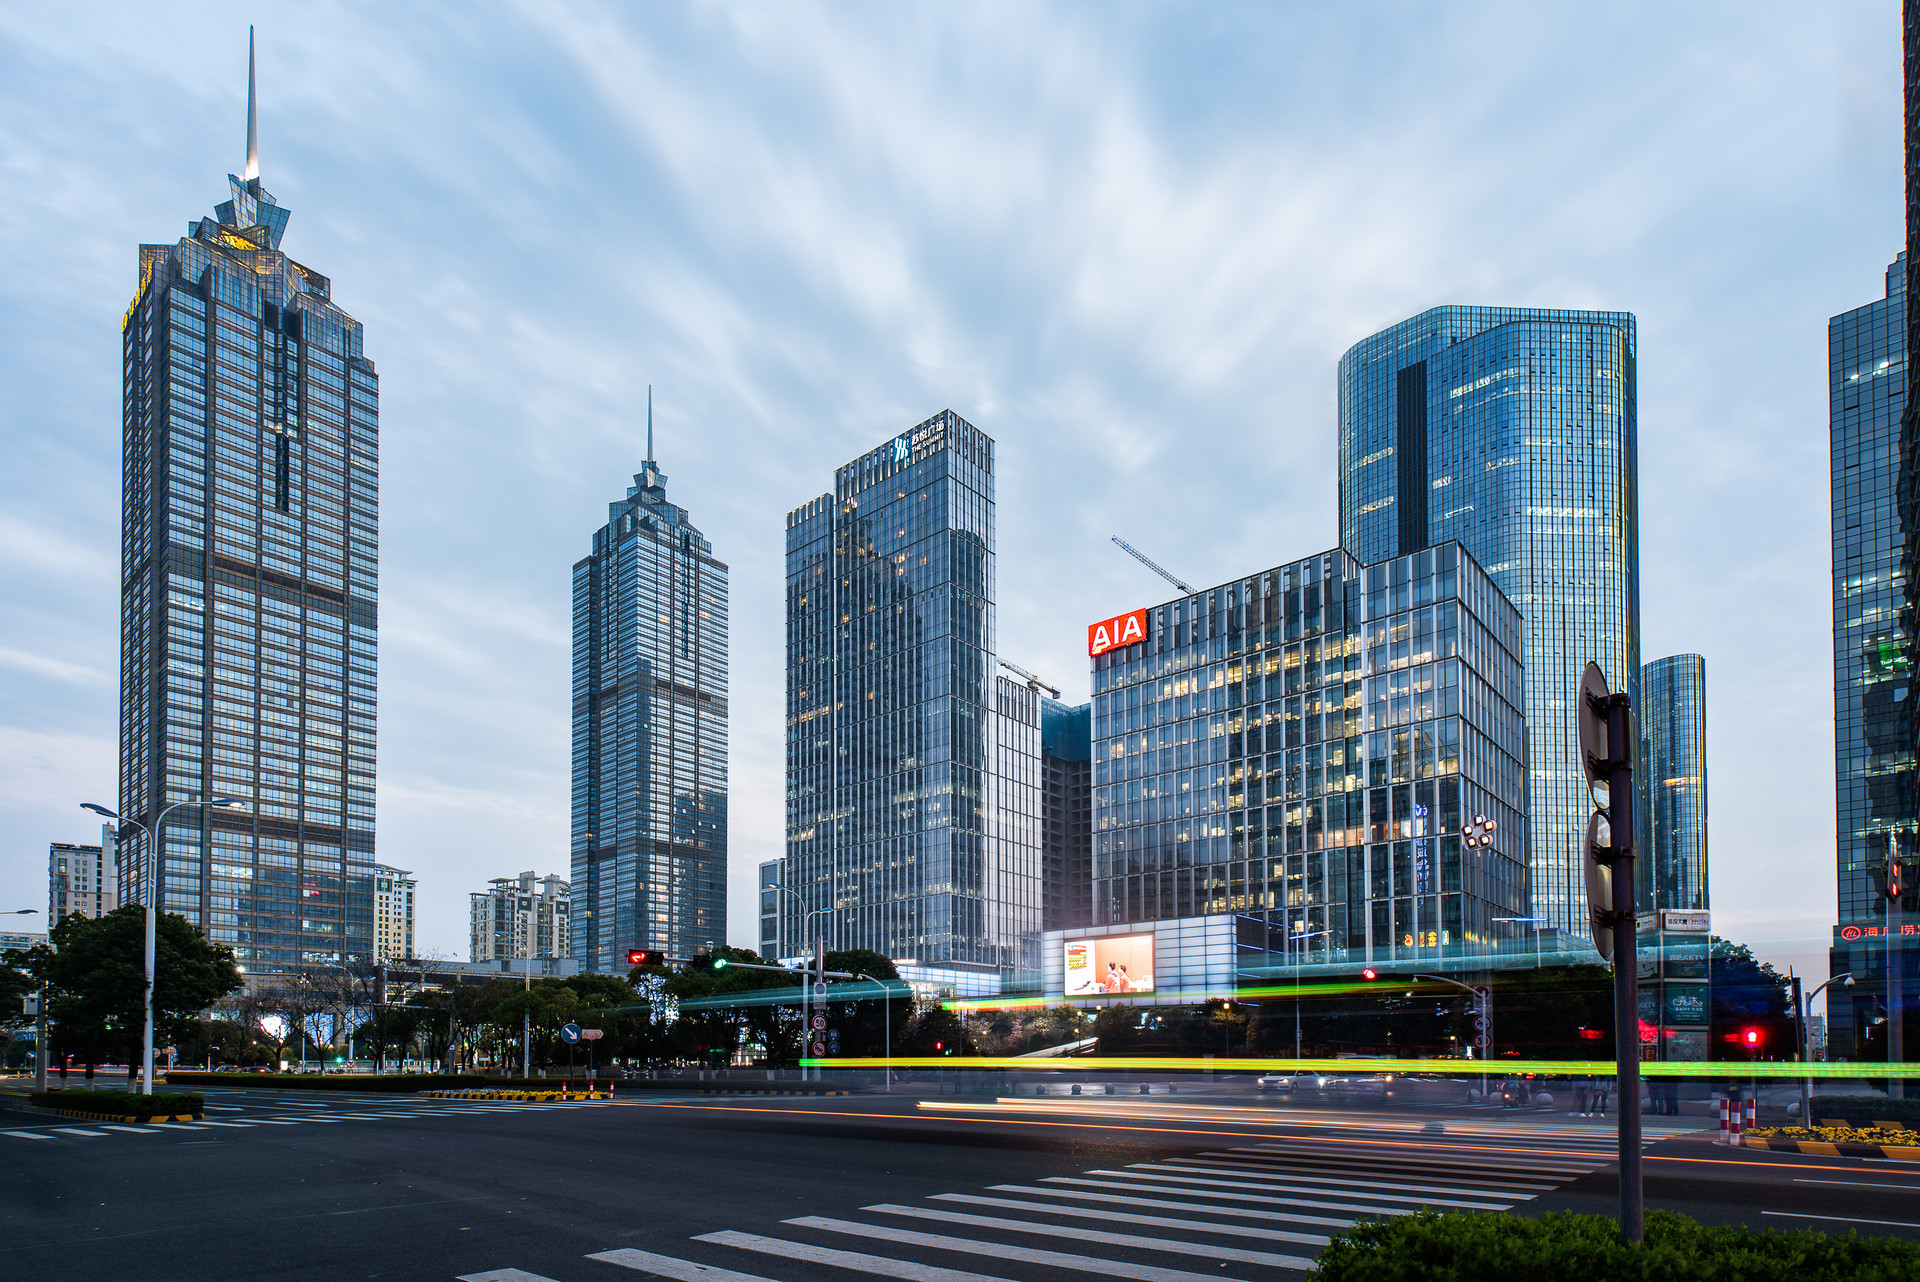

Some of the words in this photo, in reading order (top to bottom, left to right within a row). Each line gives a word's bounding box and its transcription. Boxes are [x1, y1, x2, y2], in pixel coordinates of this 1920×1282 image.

[911, 443, 922, 453] THE
[922, 431, 944, 448] SUMMIT
[1091, 615, 1143, 651] AIA
[815, 1020, 825, 1028] 50
